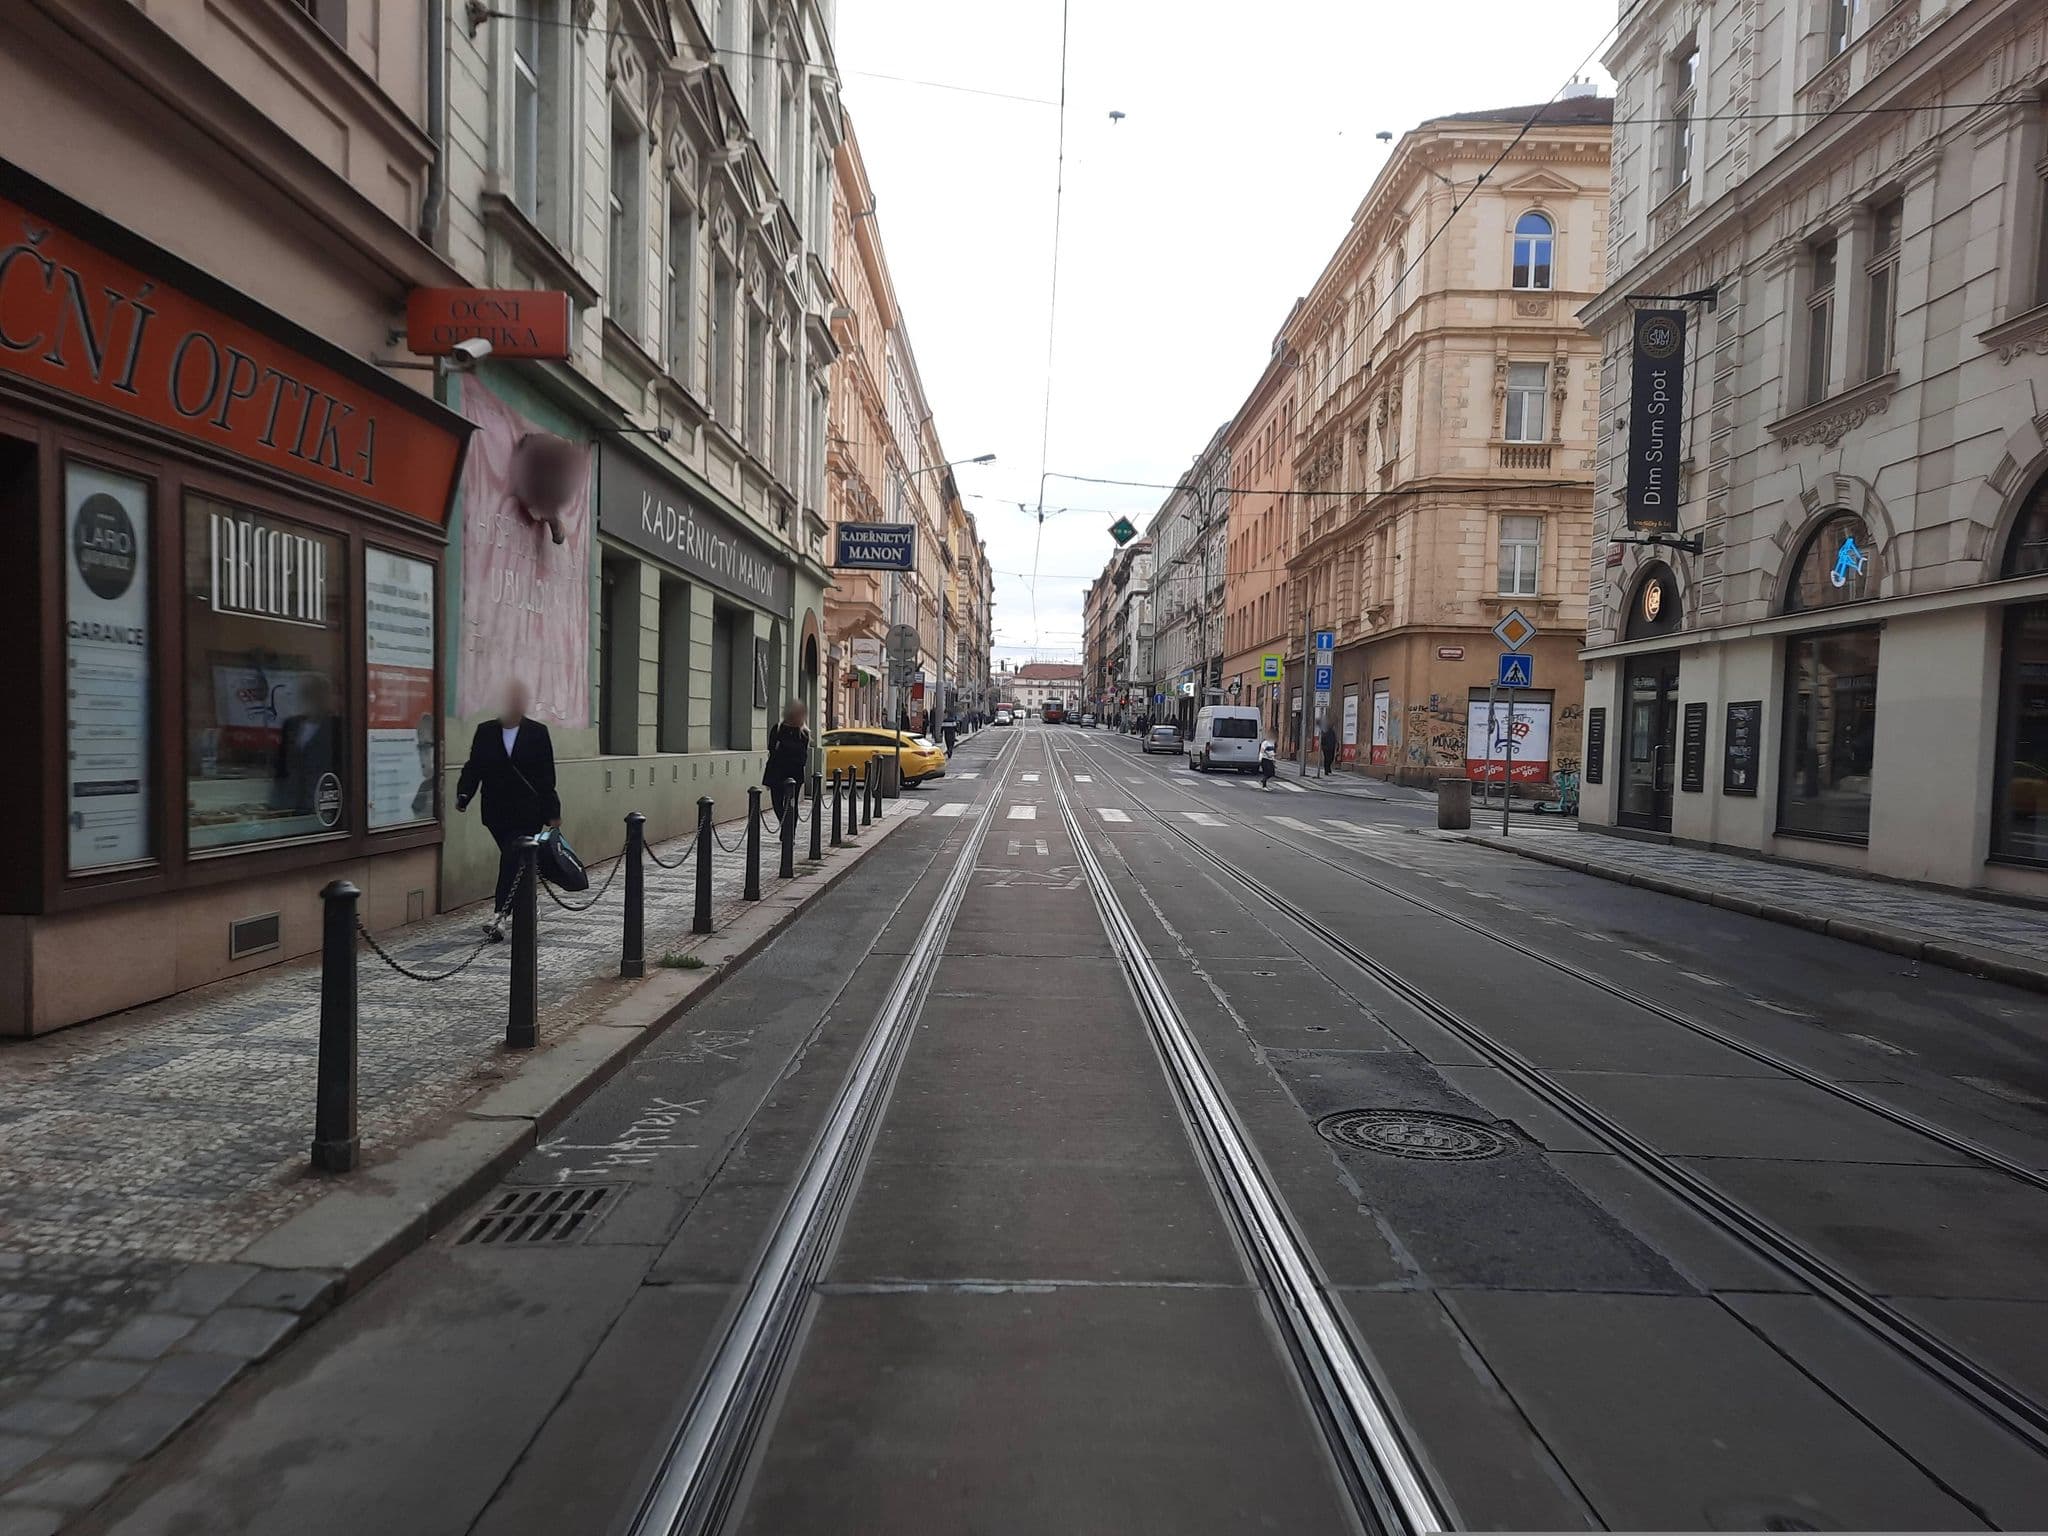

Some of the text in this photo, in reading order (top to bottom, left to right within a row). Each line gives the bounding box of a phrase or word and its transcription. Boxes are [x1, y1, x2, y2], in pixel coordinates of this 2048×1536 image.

[169, 330, 375, 486] OPTIKA
[1647, 370, 1670, 415] Spot
[1645, 420, 1664, 463] Sum
[1643, 467, 1662, 505] Dim
[641, 490, 775, 597] KADEŘNICTVÍ MANON
[841, 529, 912, 544] KADEŘNICTVÍ
[849, 546, 905, 560] MANON
